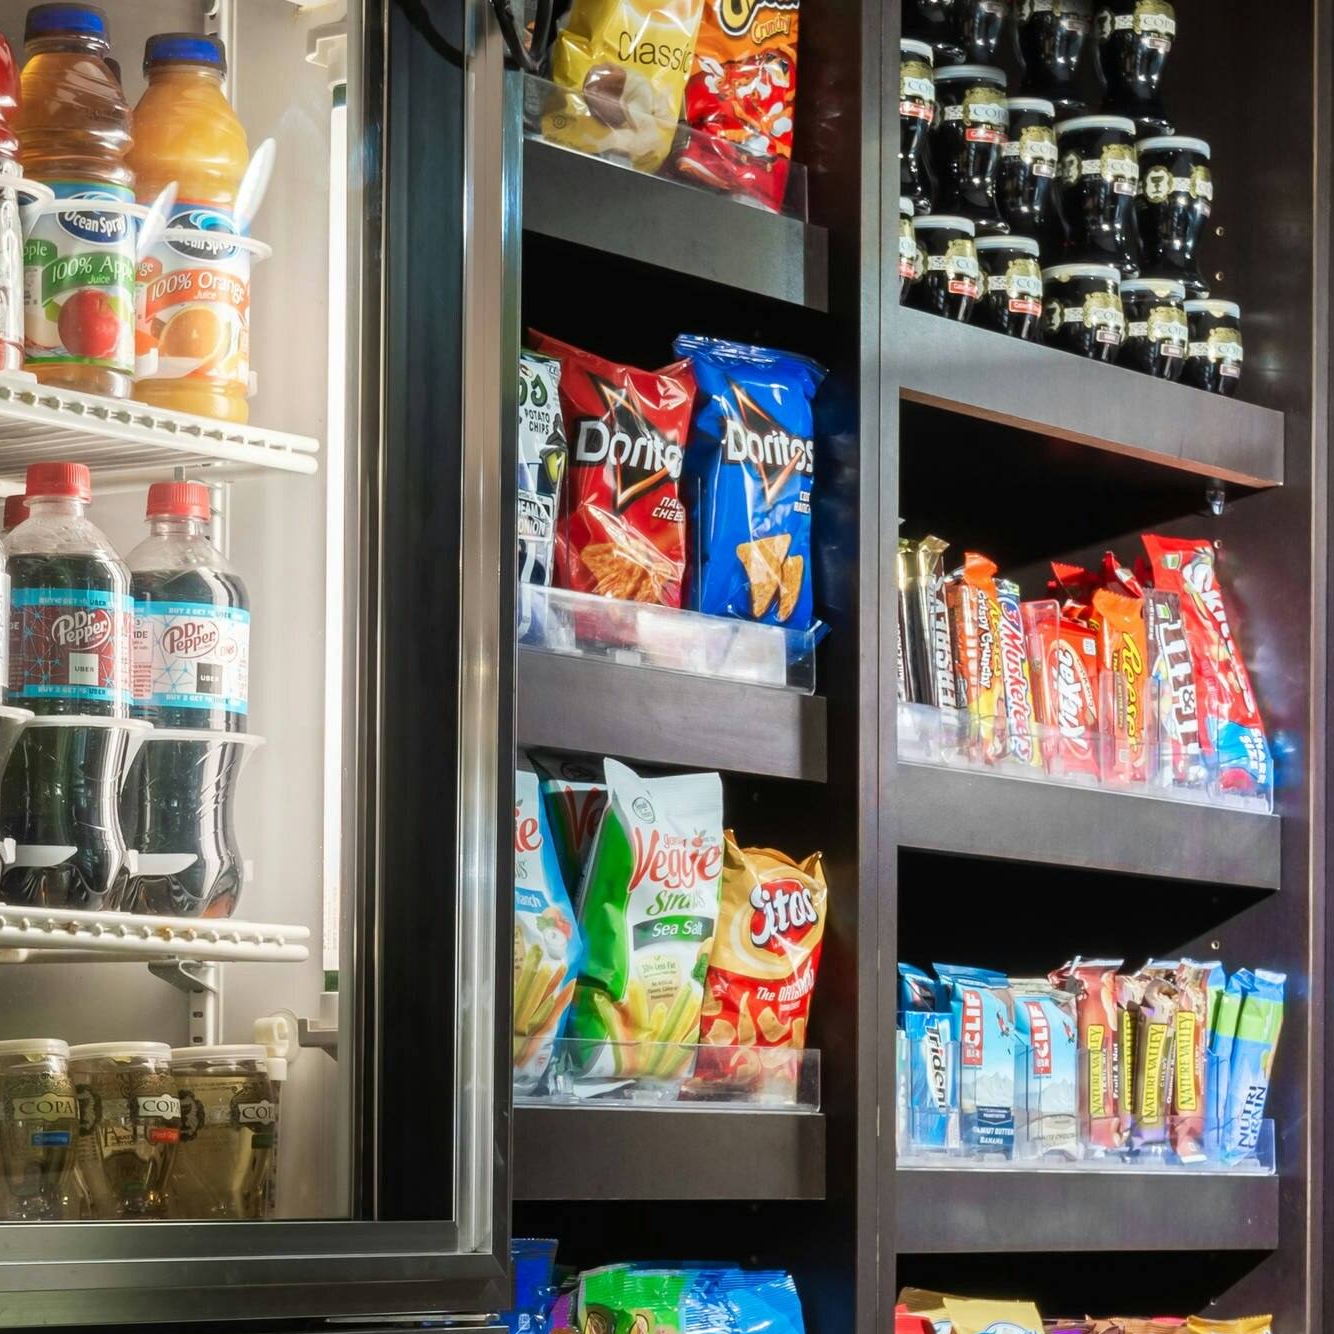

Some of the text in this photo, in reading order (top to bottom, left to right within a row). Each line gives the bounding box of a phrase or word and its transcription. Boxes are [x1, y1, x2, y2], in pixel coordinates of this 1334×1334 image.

[751, 13, 792, 44] Crunchy
[618, 31, 692, 74] Classic
[64, 211, 127, 240] Ocean Spray
[51, 256, 93, 283] 100%
[88, 275, 111, 285] Juice
[150, 271, 245, 304] 100% Orange
[193, 290, 216, 300] Juice
[525, 409, 551, 423] POTATO
[528, 421, 550, 435] CHIPS
[725, 417, 815, 476] Doritos
[59, 617, 109, 647] Pepper
[75, 610, 93, 629] Dr
[184, 622, 204, 639] Dr
[169, 625, 216, 655] Pepper
[977, 589, 991, 689] Crispy Crunchy
[74, 665, 95, 673] UBER
[200, 674, 220, 682] UBER
[1000, 620, 1031, 760] Musketeers
[1239, 735, 1259, 770] SIZE
[1250, 727, 1267, 784] SHARE
[628, 826, 723, 893] Veggie
[652, 919, 704, 938] Sea Salt
[756, 986, 776, 1001] The
[964, 991, 982, 1046] CLIF
[1027, 1003, 1050, 1059] CLIF
[925, 1020, 948, 1113] Trident
[1089, 1028, 1105, 1115] NATURE VALLEY
[1143, 1027, 1165, 1119] NATURE VALLEY
[1179, 1015, 1195, 1106] NATURE VALLEY
[1238, 1085, 1257, 1149] NUTRI
[1248, 1086, 1267, 1150] GRAIN
[978, 1136, 1004, 1145] BANANA
